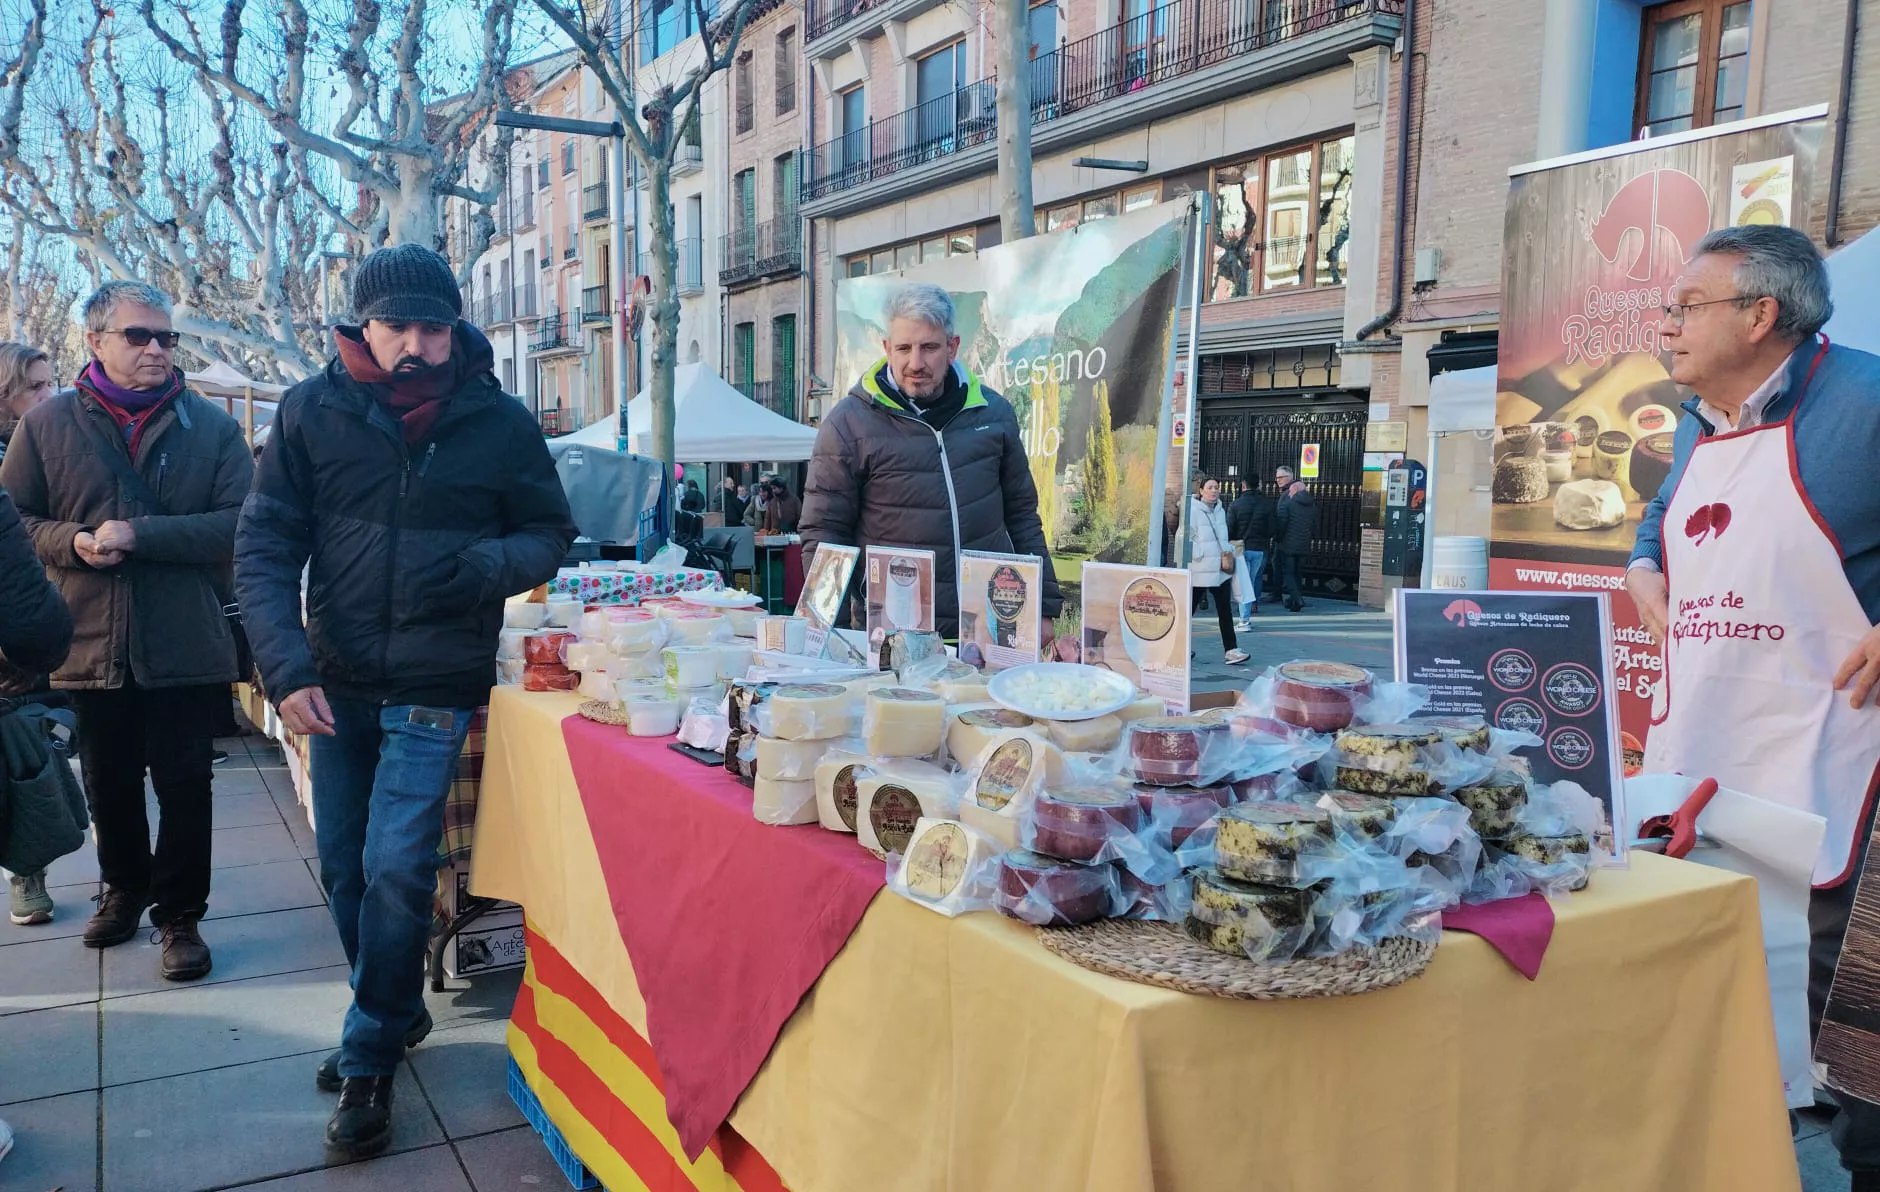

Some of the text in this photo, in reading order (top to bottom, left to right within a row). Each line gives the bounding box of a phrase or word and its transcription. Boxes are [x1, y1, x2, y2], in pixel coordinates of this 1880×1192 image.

[1584, 284, 1662, 322] Quesos
[1019, 400, 1060, 457] illo
[1413, 469, 1424, 486] P
[1436, 575, 1467, 588] LAUS
[1720, 590, 1745, 609] de
[1467, 611, 1570, 622] Quesos de Radiquero
[1546, 686, 1597, 694] WORLD CHEESE
